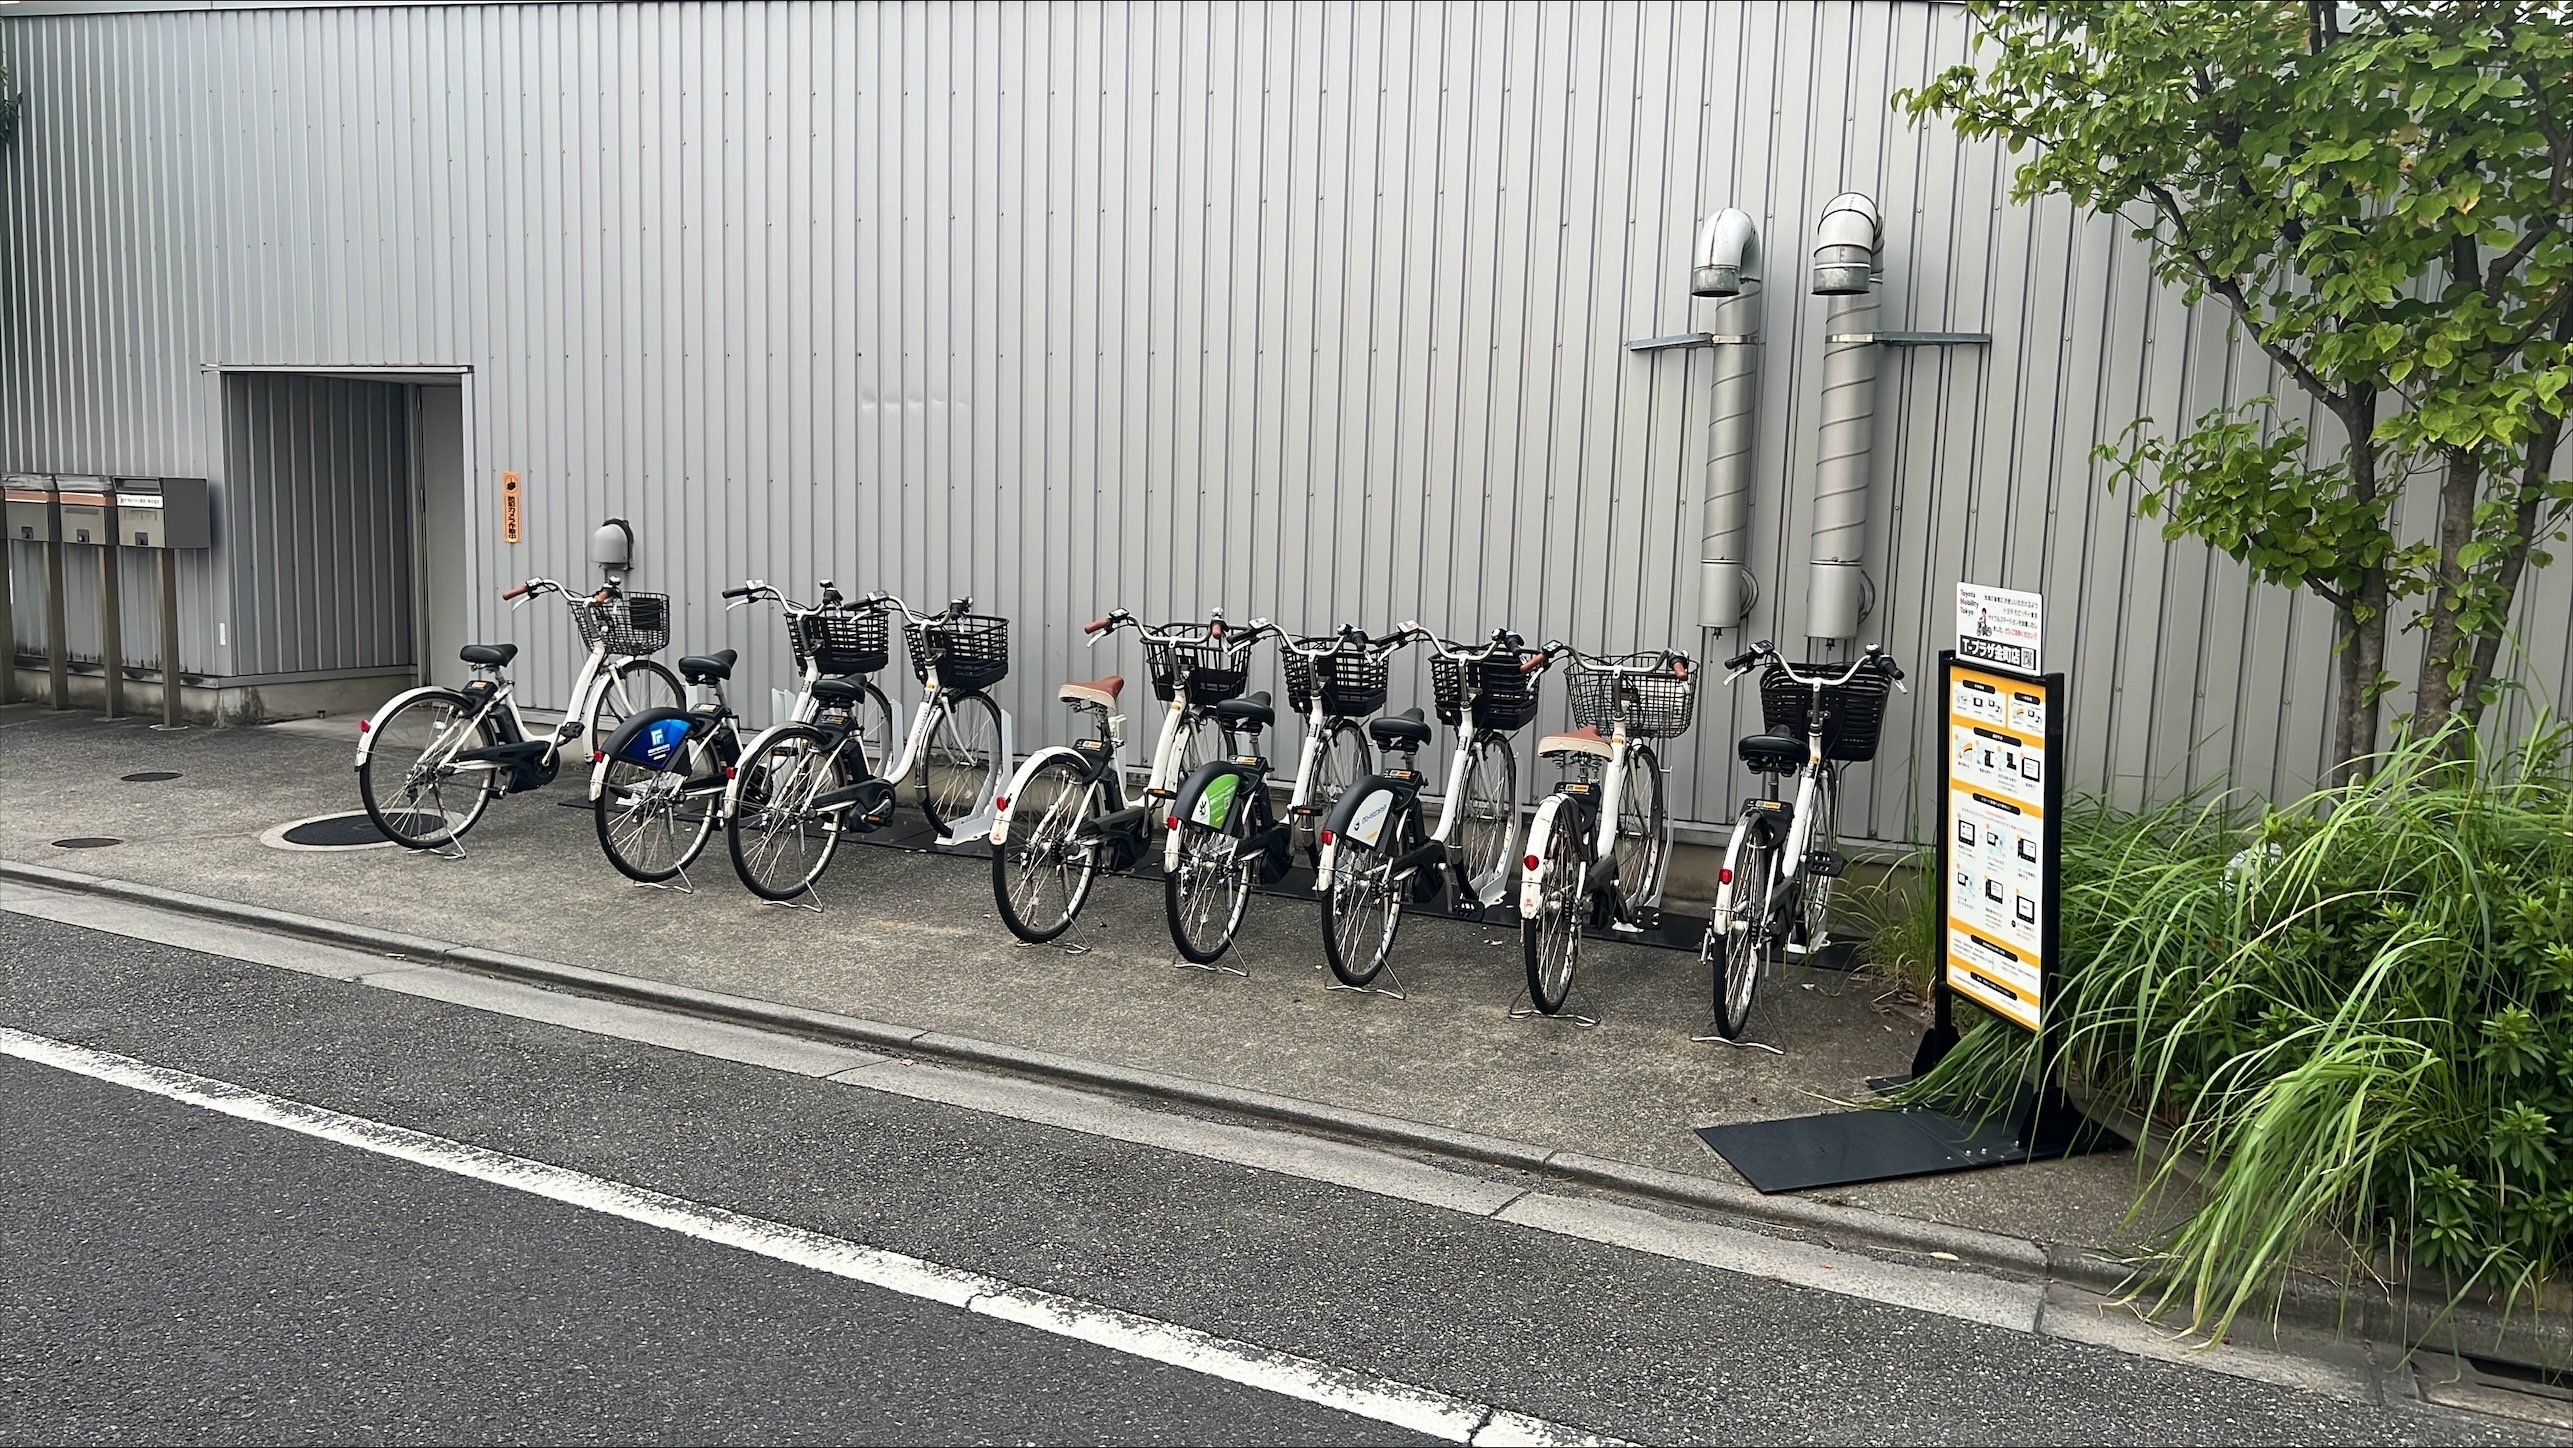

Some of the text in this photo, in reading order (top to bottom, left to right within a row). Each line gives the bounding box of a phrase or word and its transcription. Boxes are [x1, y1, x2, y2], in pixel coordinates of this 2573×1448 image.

[1960, 590, 1976, 598] Toyota
[1960, 598, 1979, 609] Mobility
[1960, 606, 1974, 616] Tokyo
